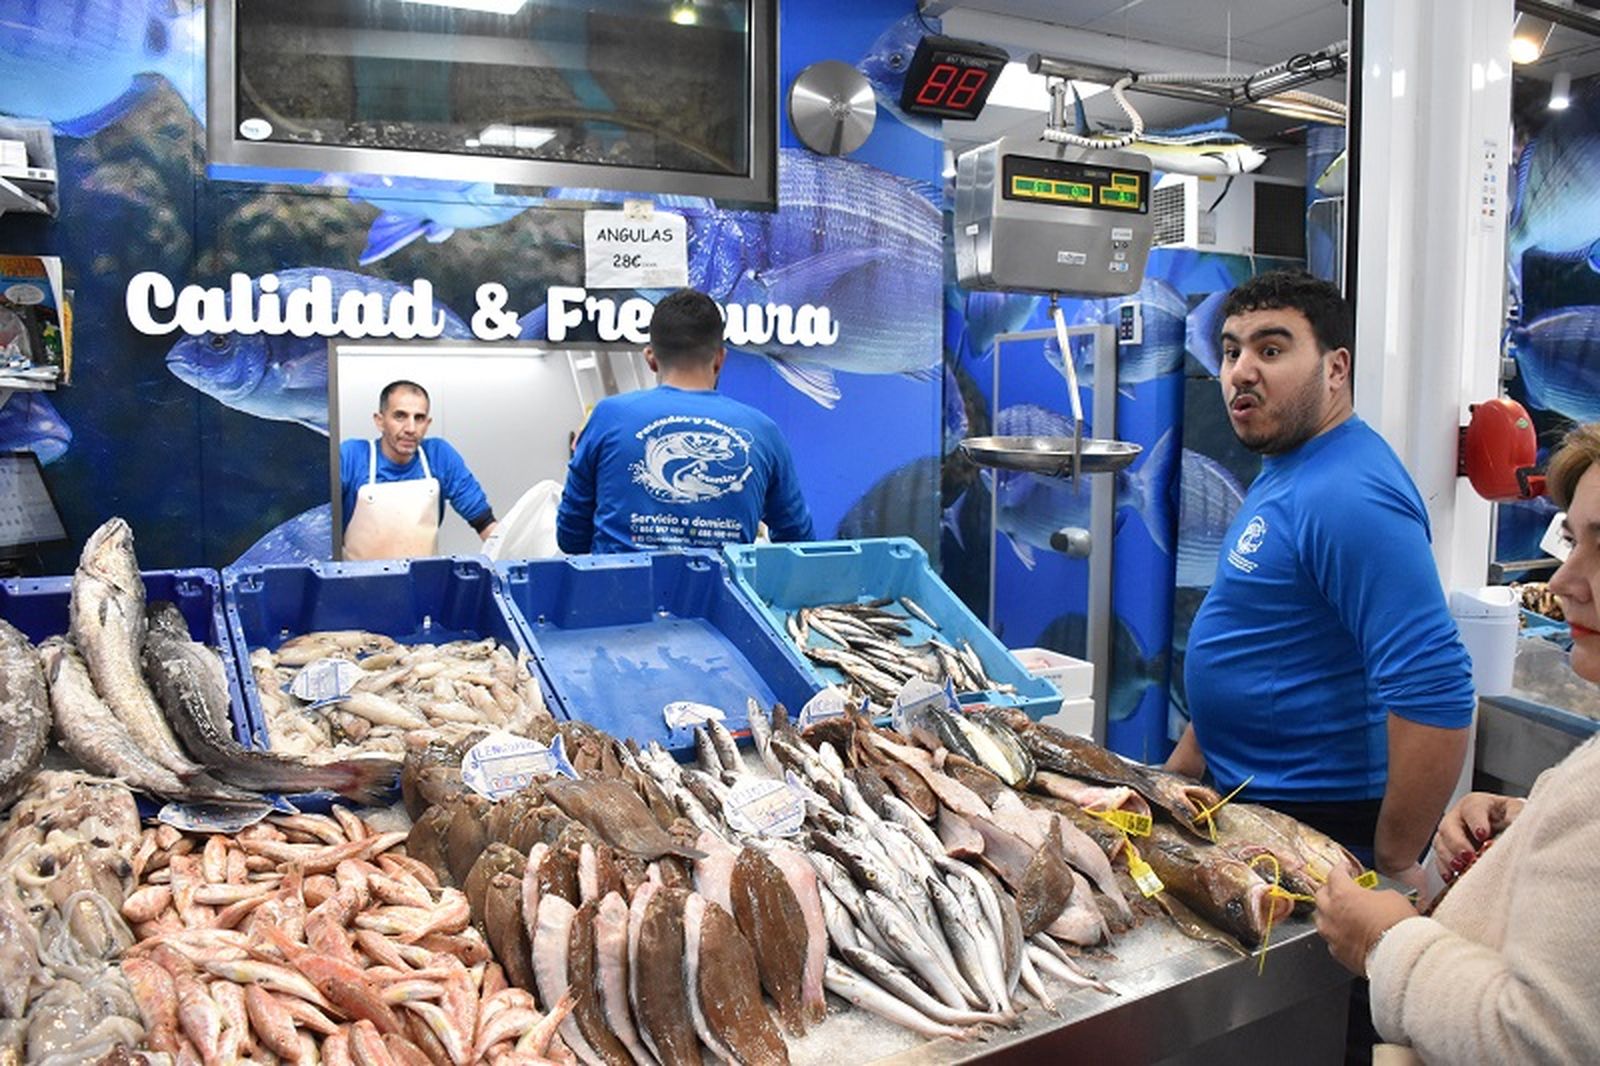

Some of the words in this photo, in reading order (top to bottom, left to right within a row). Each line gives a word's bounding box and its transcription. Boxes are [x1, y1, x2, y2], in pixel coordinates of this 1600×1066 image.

[916, 63, 988, 109] 88
[597, 228, 673, 242] ANGULAS
[126, 271, 445, 339] Calidad
[471, 282, 522, 341] &
[547, 287, 839, 346] Freura
[631, 512, 679, 524] Servicio
[681, 517, 689, 526] a
[692, 516, 742, 530] domicilio
